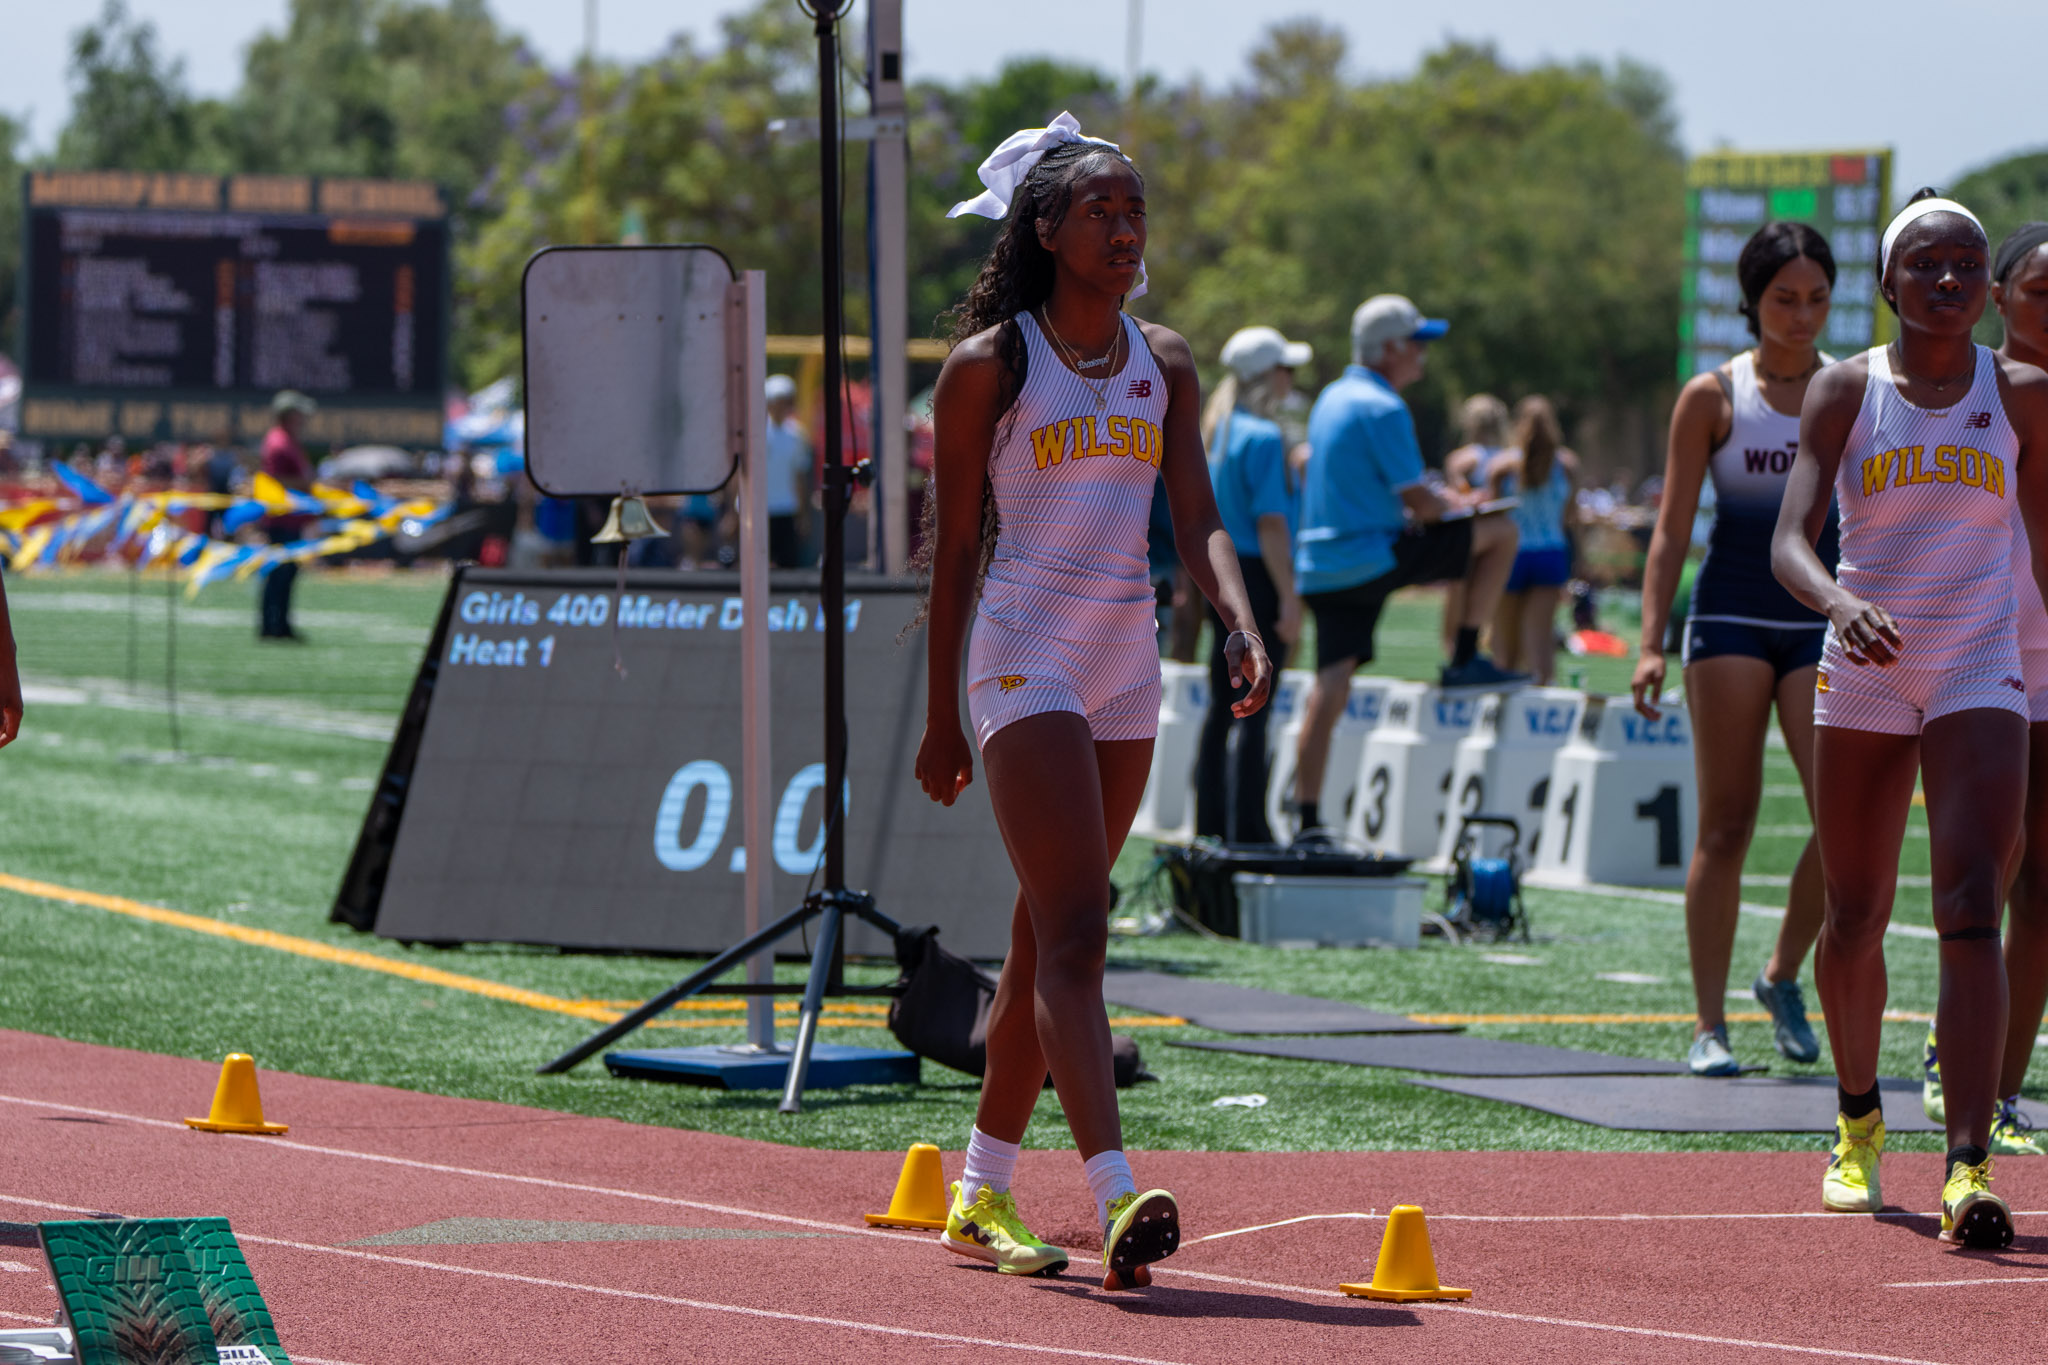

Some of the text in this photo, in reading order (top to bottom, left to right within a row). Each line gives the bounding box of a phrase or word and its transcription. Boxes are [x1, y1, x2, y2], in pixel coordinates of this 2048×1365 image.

[1862, 445, 2004, 499] WILSON
[460, 591, 540, 625] Girls
[546, 594, 610, 627] 400
[617, 595, 715, 630] Meter
[718, 597, 808, 632] Dsh
[449, 632, 556, 667] Heat 1
[654, 759, 850, 875] 0.0
[1364, 765, 1390, 842] 3
[1561, 783, 1579, 863] 1
[1634, 783, 1682, 868] 1
[86, 1255, 166, 1283] GILL
[218, 1349, 260, 1360] GILL
